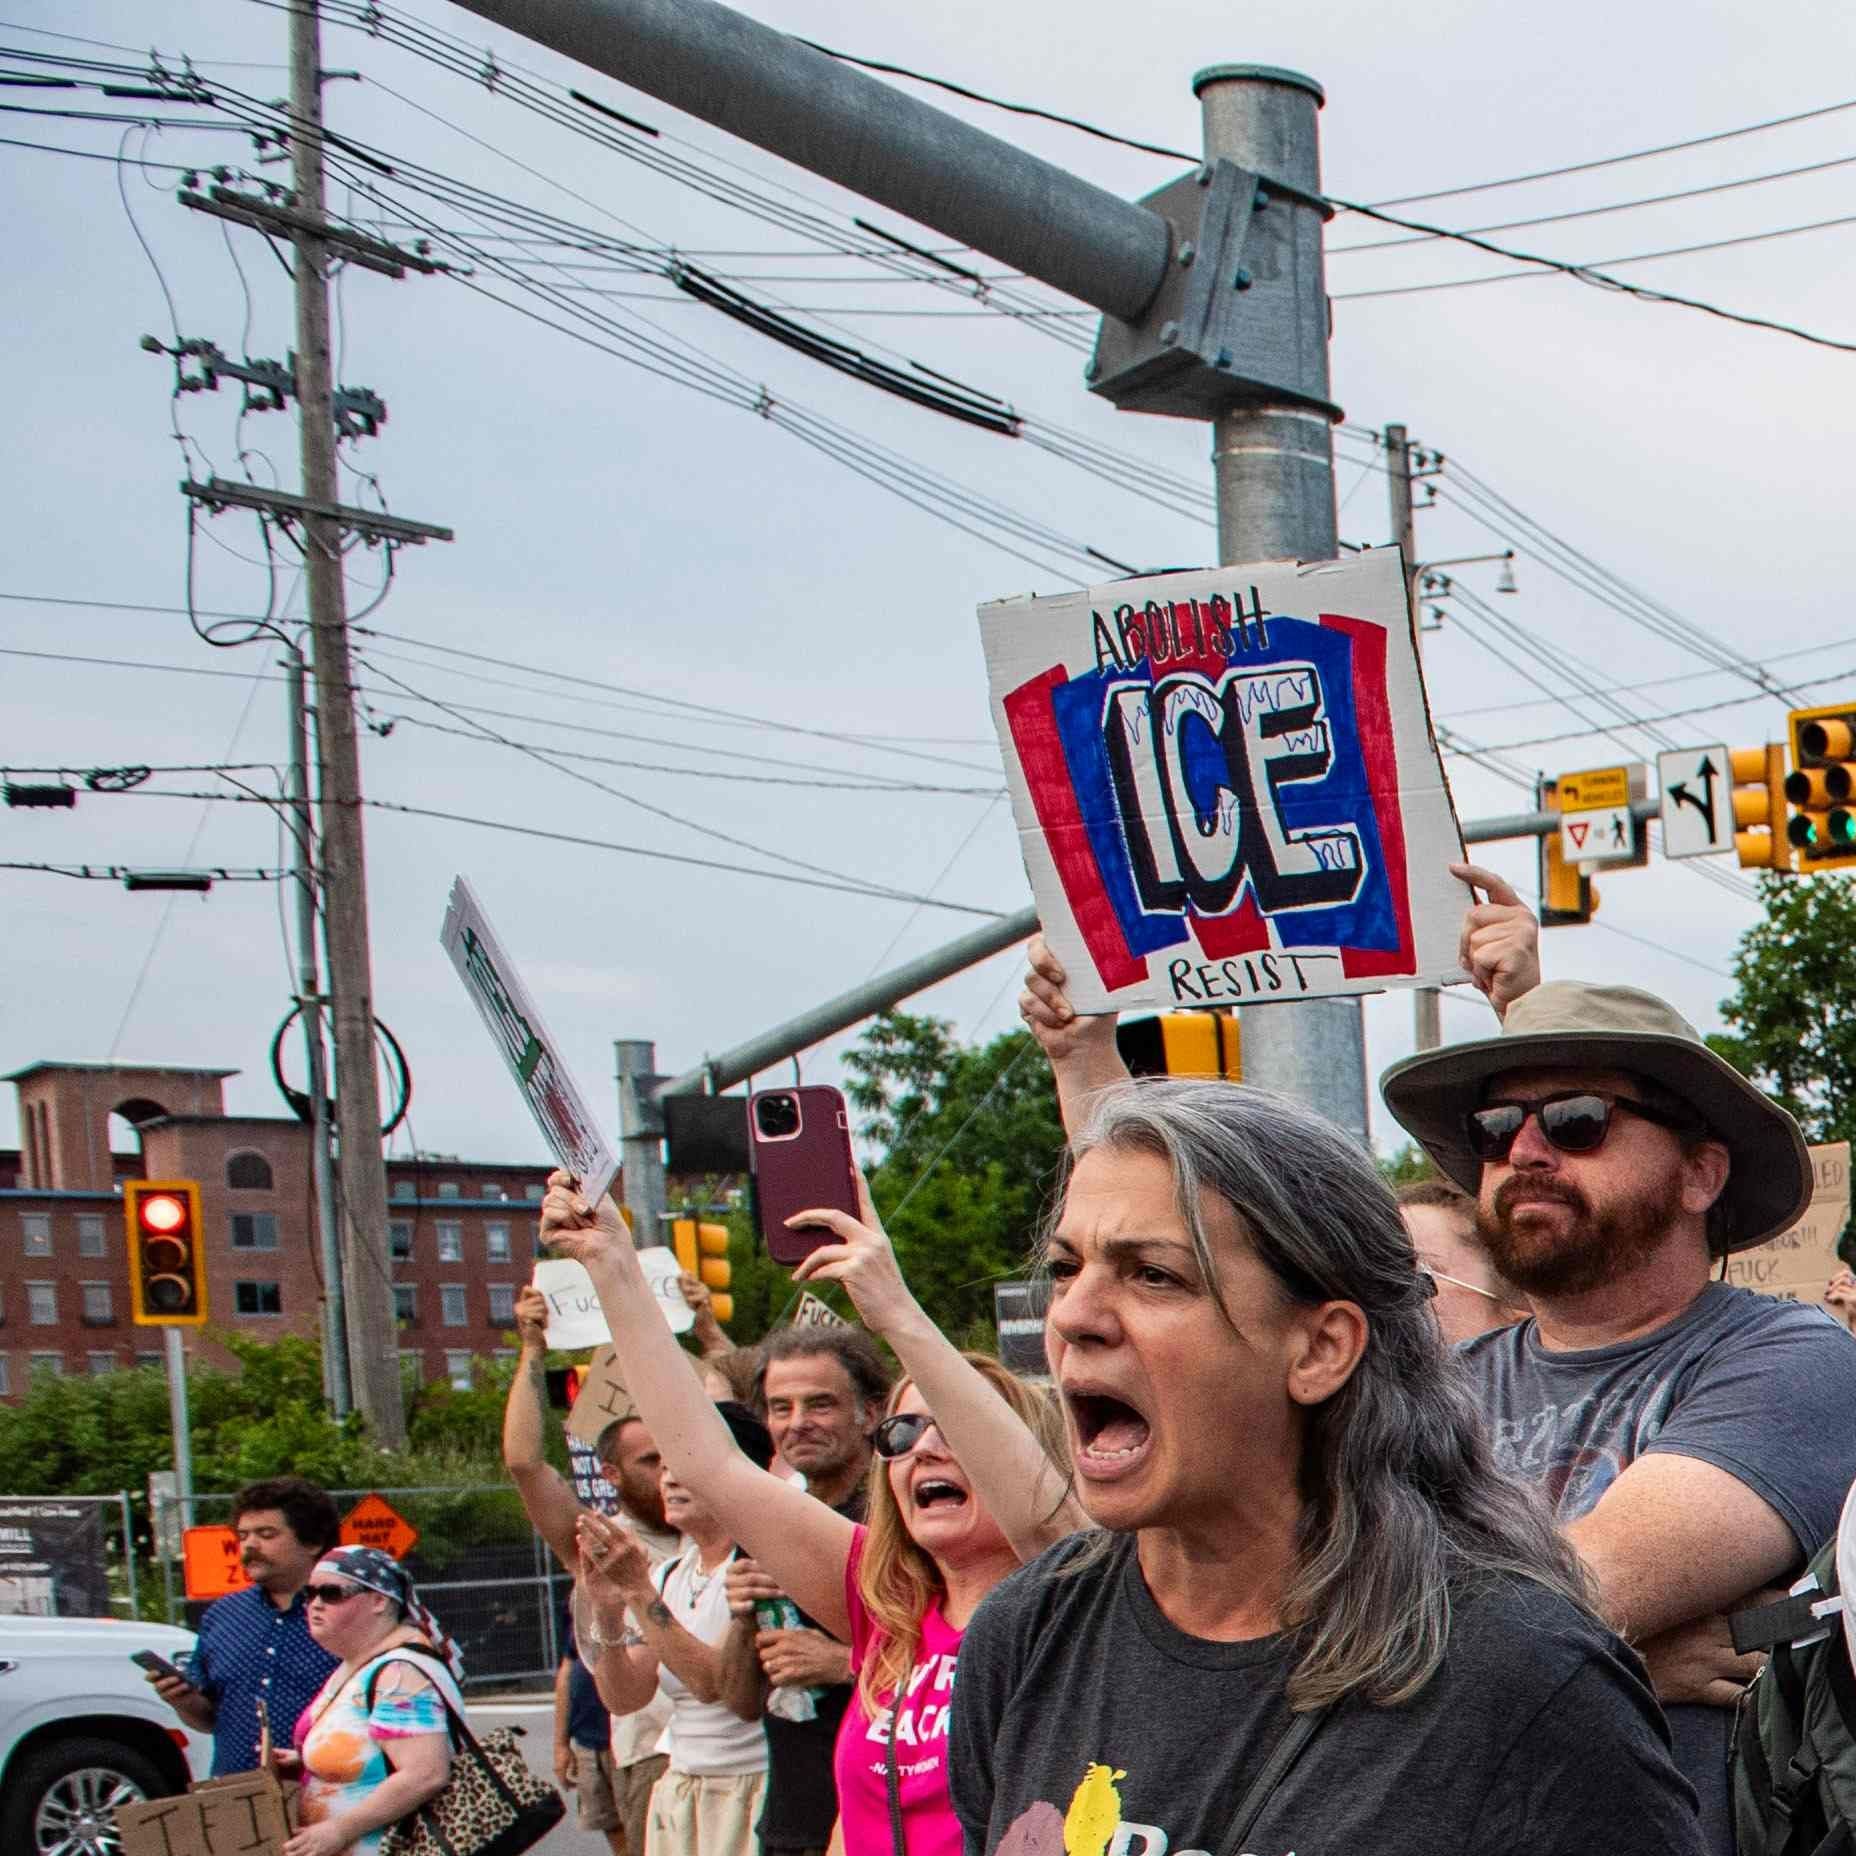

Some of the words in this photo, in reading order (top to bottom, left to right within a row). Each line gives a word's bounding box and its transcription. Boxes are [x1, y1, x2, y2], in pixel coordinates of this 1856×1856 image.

[1092, 586, 1272, 675] ABOLISH
[1102, 659, 1367, 918] ICE
[1168, 952, 1338, 1001] RESIST
